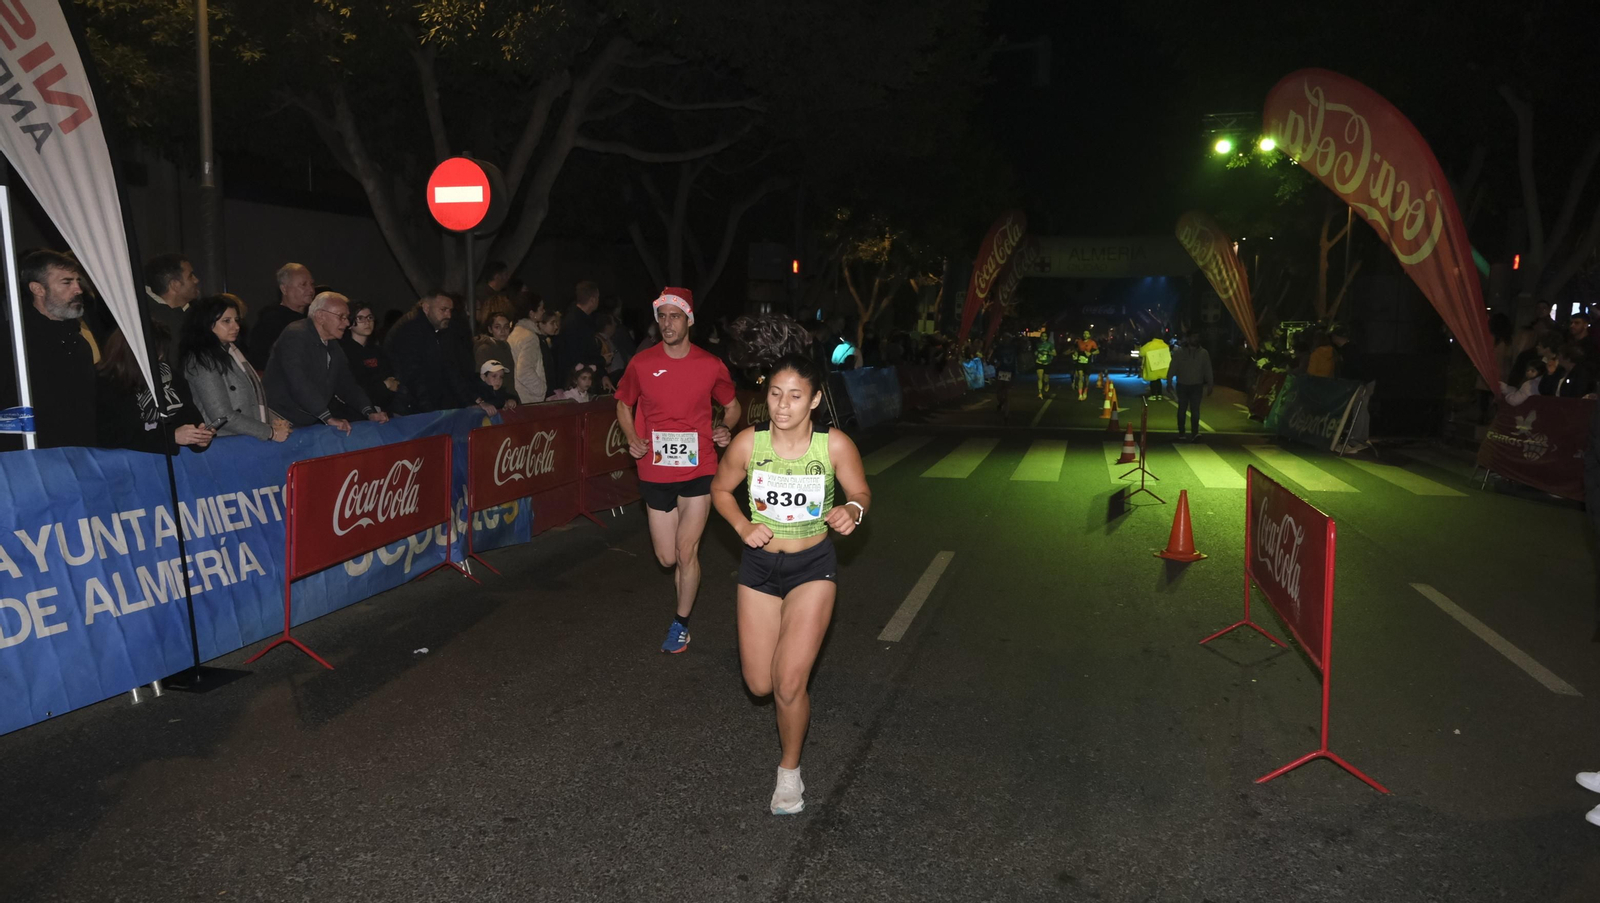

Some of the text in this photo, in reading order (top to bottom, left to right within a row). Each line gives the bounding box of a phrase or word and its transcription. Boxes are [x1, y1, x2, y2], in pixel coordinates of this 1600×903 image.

[493, 429, 557, 486] Coca-Cola
[662, 443, 688, 455] 152
[333, 457, 423, 536] Coca-Cola
[766, 490, 807, 507] 830
[0, 484, 287, 579] AYUNTAMIENT
[0, 537, 266, 649] DE ALMERÍA
